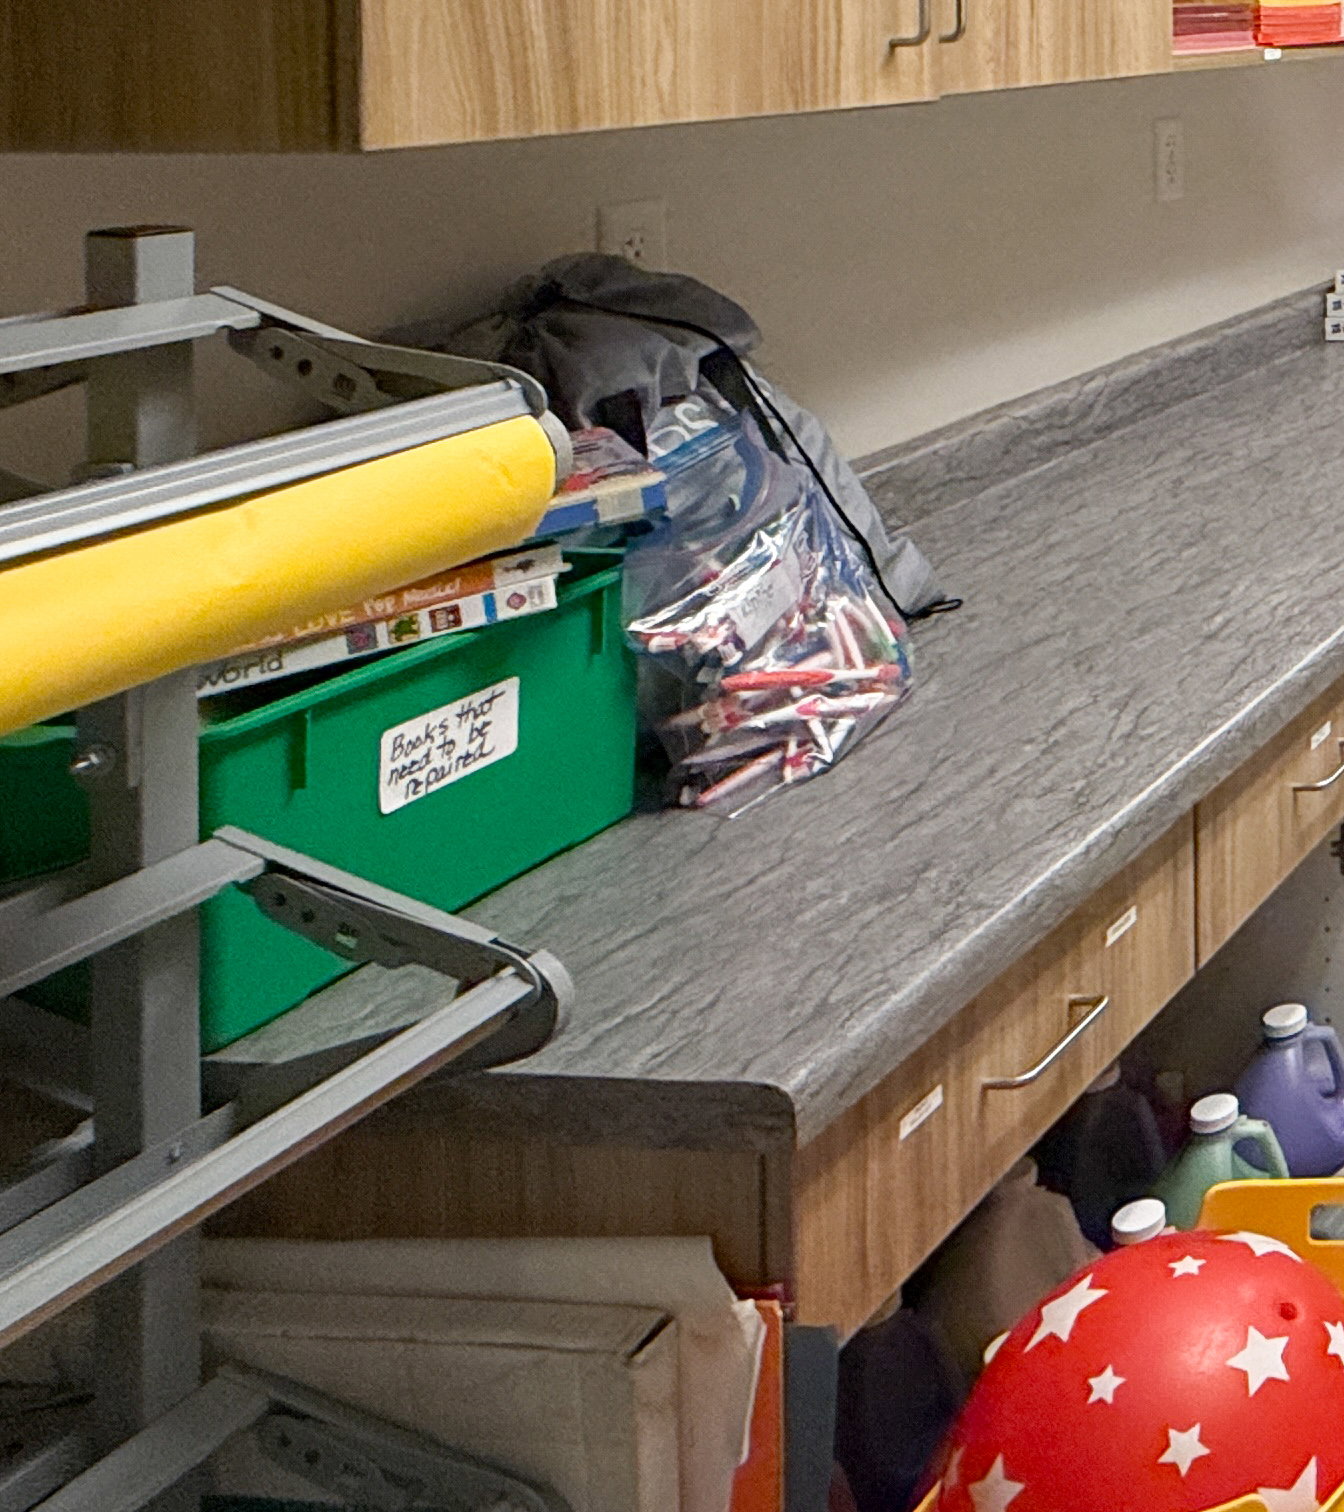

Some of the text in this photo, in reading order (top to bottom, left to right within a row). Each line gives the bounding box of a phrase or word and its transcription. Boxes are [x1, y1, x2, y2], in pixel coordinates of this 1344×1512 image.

[387, 720, 493, 786] need to be
[390, 689, 506, 762] Books that
[404, 738, 495, 800] repaired
